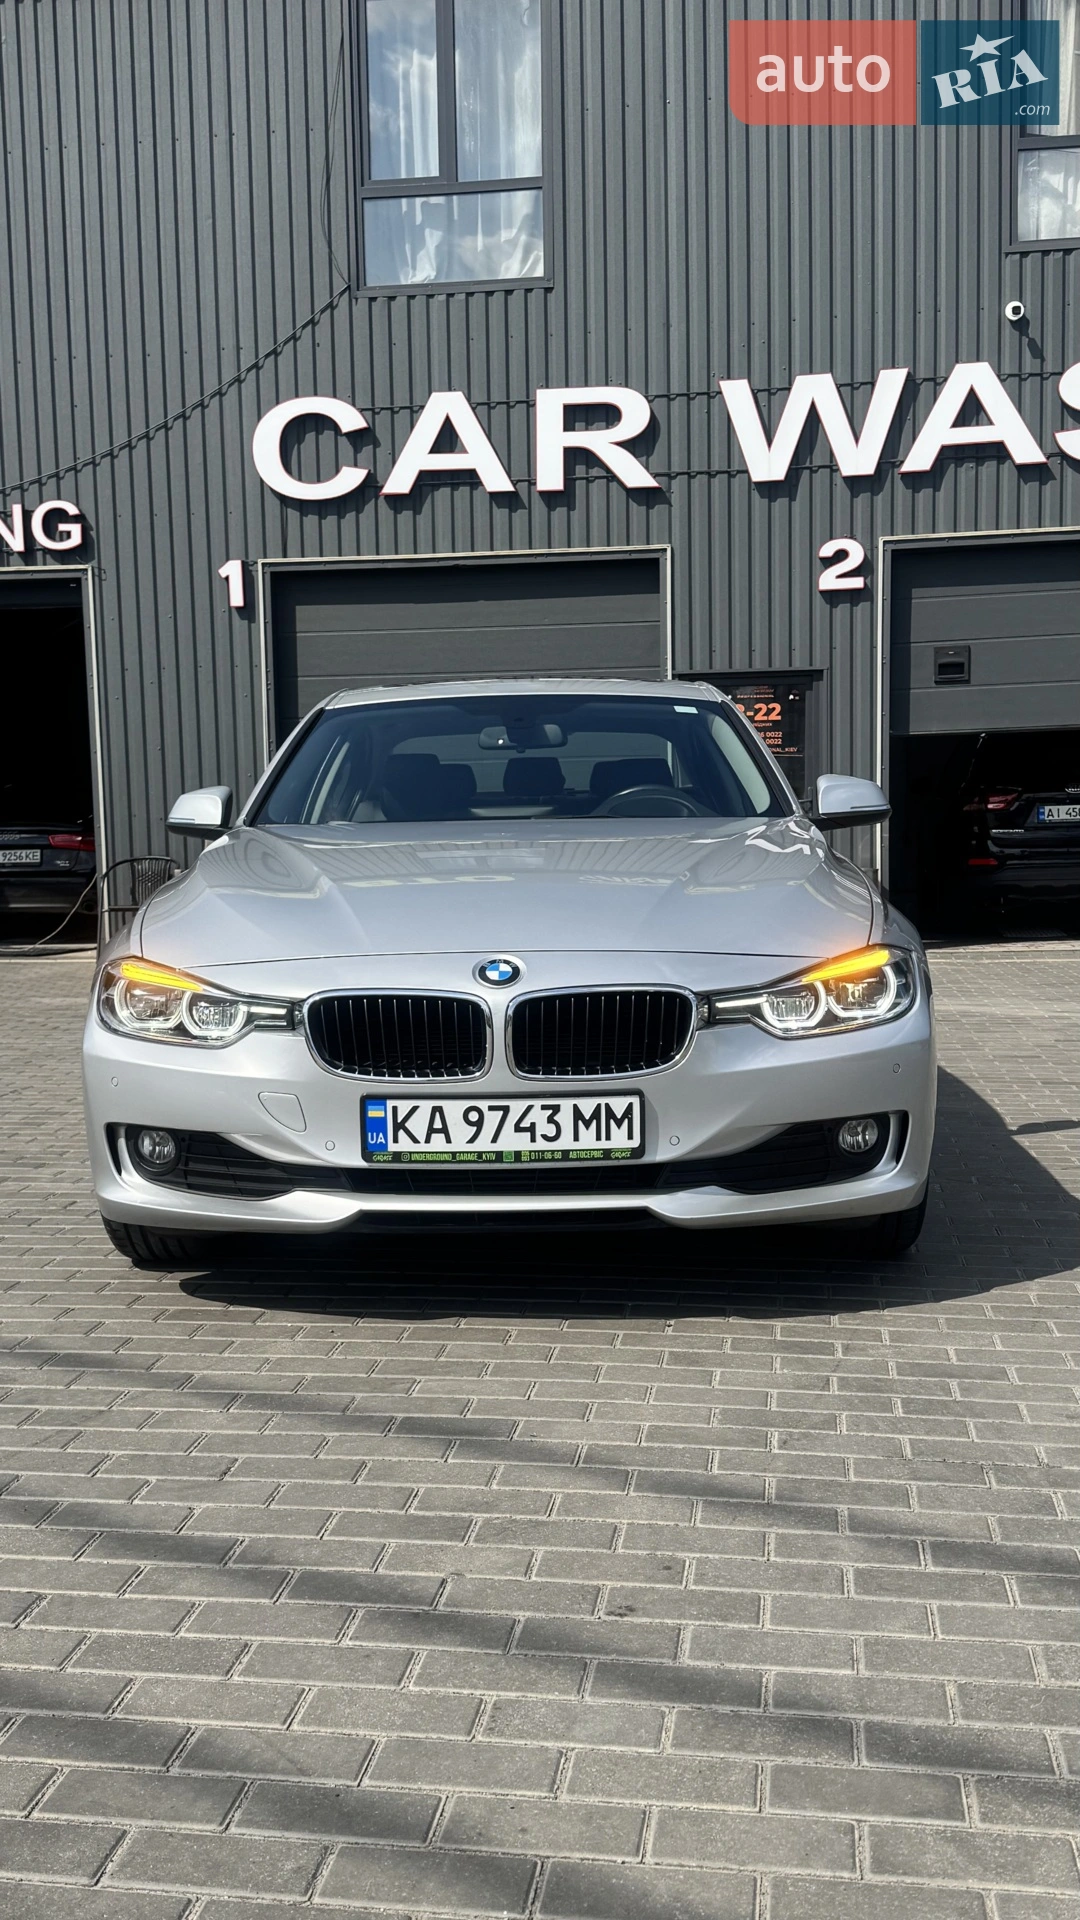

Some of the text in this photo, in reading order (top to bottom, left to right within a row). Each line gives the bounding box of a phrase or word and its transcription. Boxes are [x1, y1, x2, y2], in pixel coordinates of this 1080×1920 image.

[252, 361, 1080, 500] CAR WA
[218, 559, 245, 607] 1
[818, 538, 865, 591] 2
[1046, 807, 1080, 819] AI 45
[1, 850, 39, 861] 9256 KE
[368, 1132, 386, 1144] UA
[392, 1101, 634, 1144] KA 9743 MM
